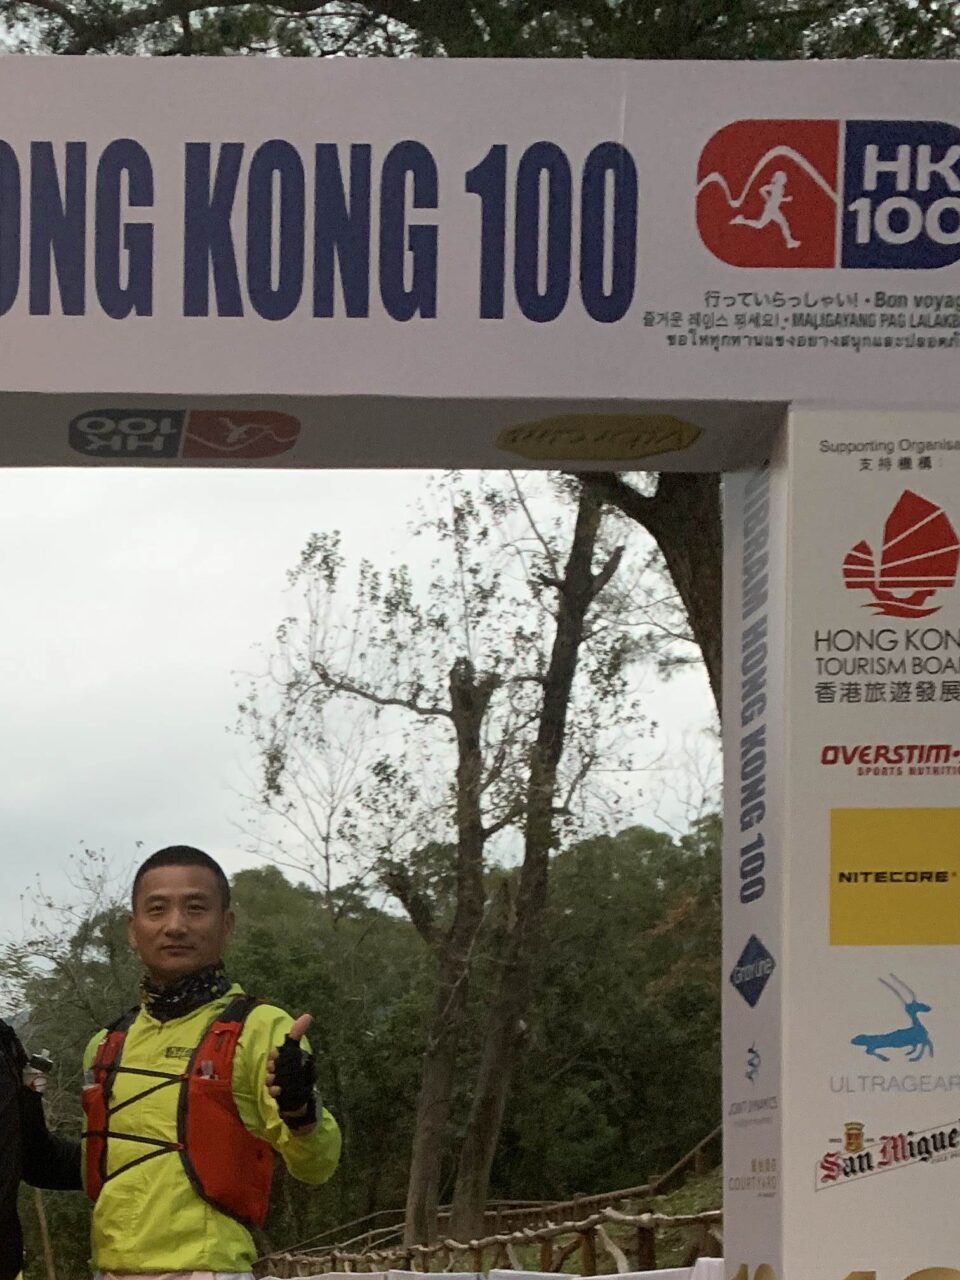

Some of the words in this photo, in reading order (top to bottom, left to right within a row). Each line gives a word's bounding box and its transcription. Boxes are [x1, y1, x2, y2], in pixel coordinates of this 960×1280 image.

[862, 144, 960, 192] HK
[183, 139, 439, 322] KONG
[465, 141, 638, 323] 100
[848, 196, 960, 245] 100
[874, 291, 909, 308] Bon
[76, 416, 178, 435] 100
[85, 434, 166, 450] HK
[819, 440, 894, 454] Supporting
[814, 628, 898, 651] HONG
[741, 614, 768, 728] HONG
[816, 657, 907, 676] TOURISM
[912, 656, 960, 675] BOA
[740, 723, 767, 833] KONG
[857, 766, 903, 776] SPORTS
[740, 832, 766, 904] 100
[838, 871, 950, 883] NITECORE
[820, 1151, 876, 1183] San
[877, 1122, 960, 1168] Migue
